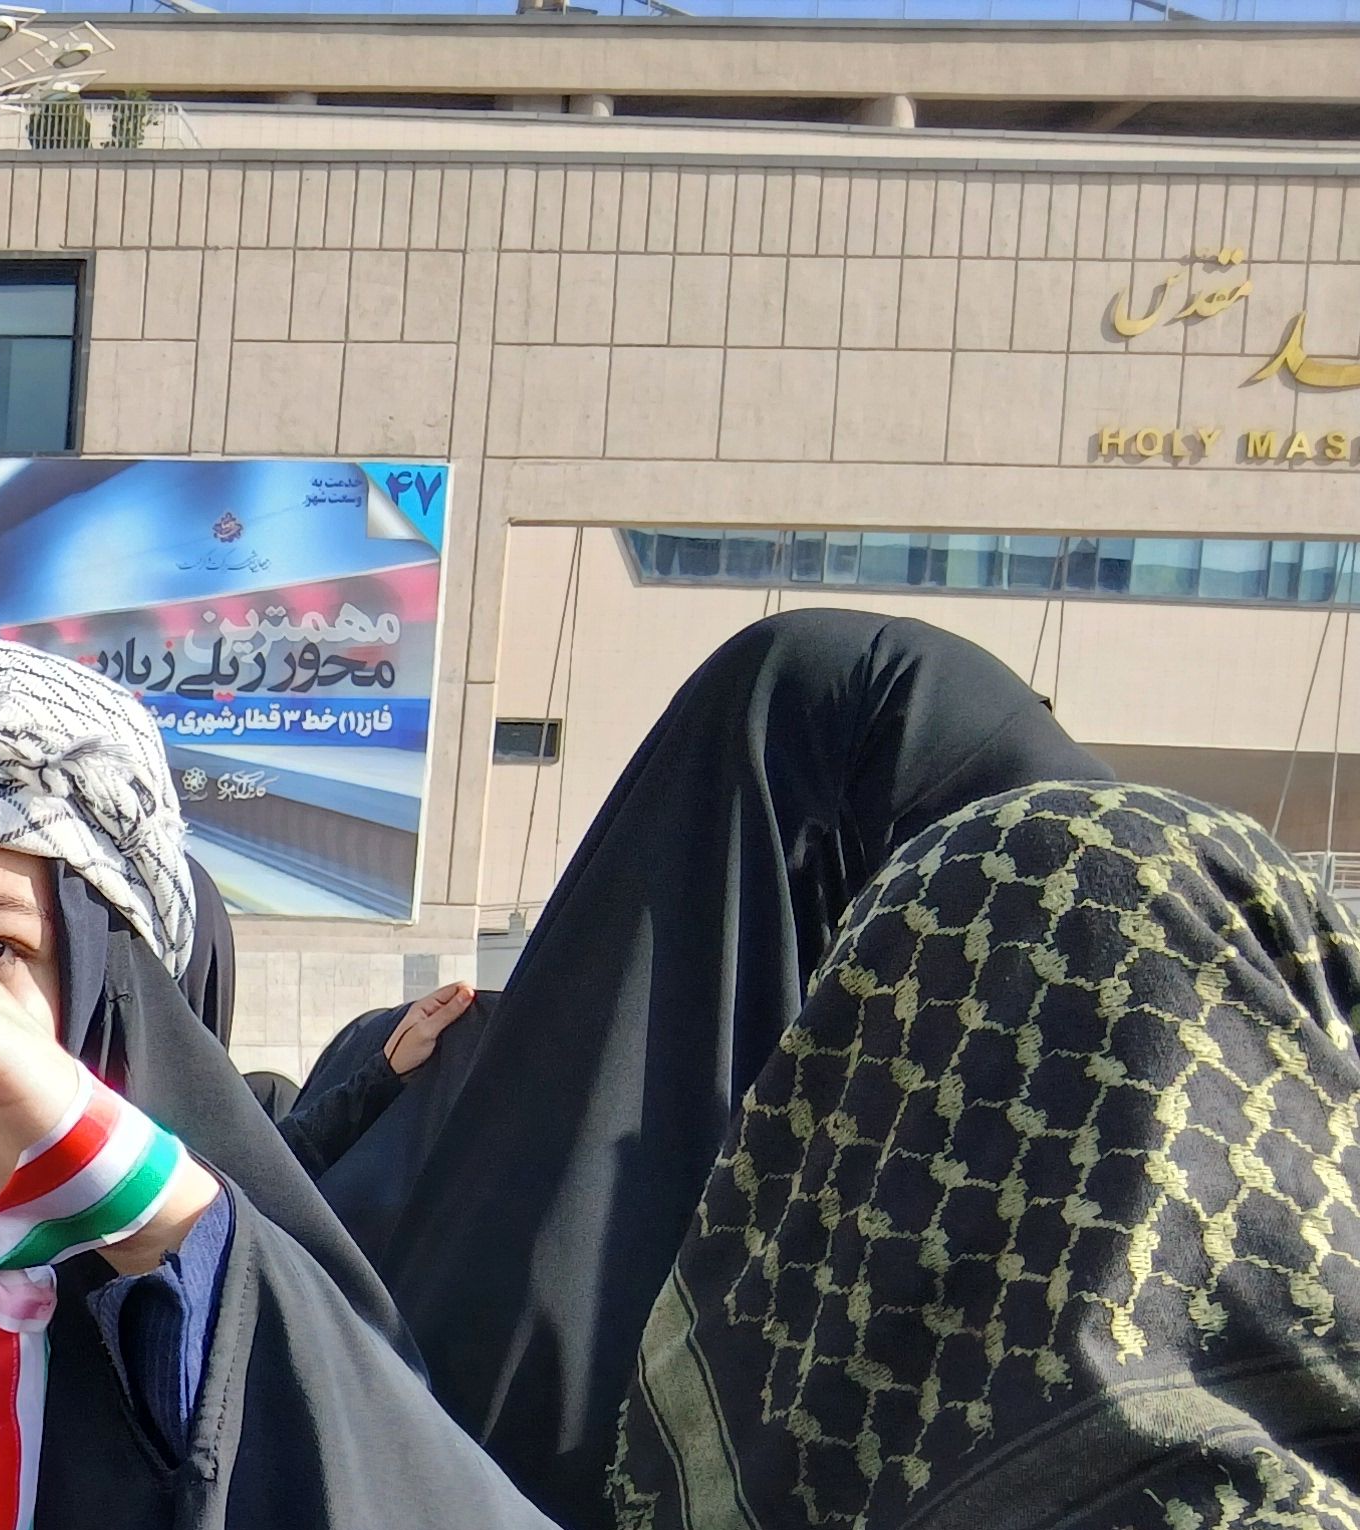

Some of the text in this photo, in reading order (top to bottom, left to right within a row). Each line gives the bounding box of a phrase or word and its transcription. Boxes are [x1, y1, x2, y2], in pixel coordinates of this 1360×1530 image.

[1099, 425, 1353, 460] HOLY MAS
[385, 471, 443, 516] ۴۷
[183, 602, 401, 663] مهمترین
[175, 636, 267, 701] ریلی
[267, 641, 396, 694] محور
[177, 706, 237, 736] شهری
[233, 703, 282, 736] قطار
[282, 711, 301, 731] ۳
[301, 706, 338, 732] خط
